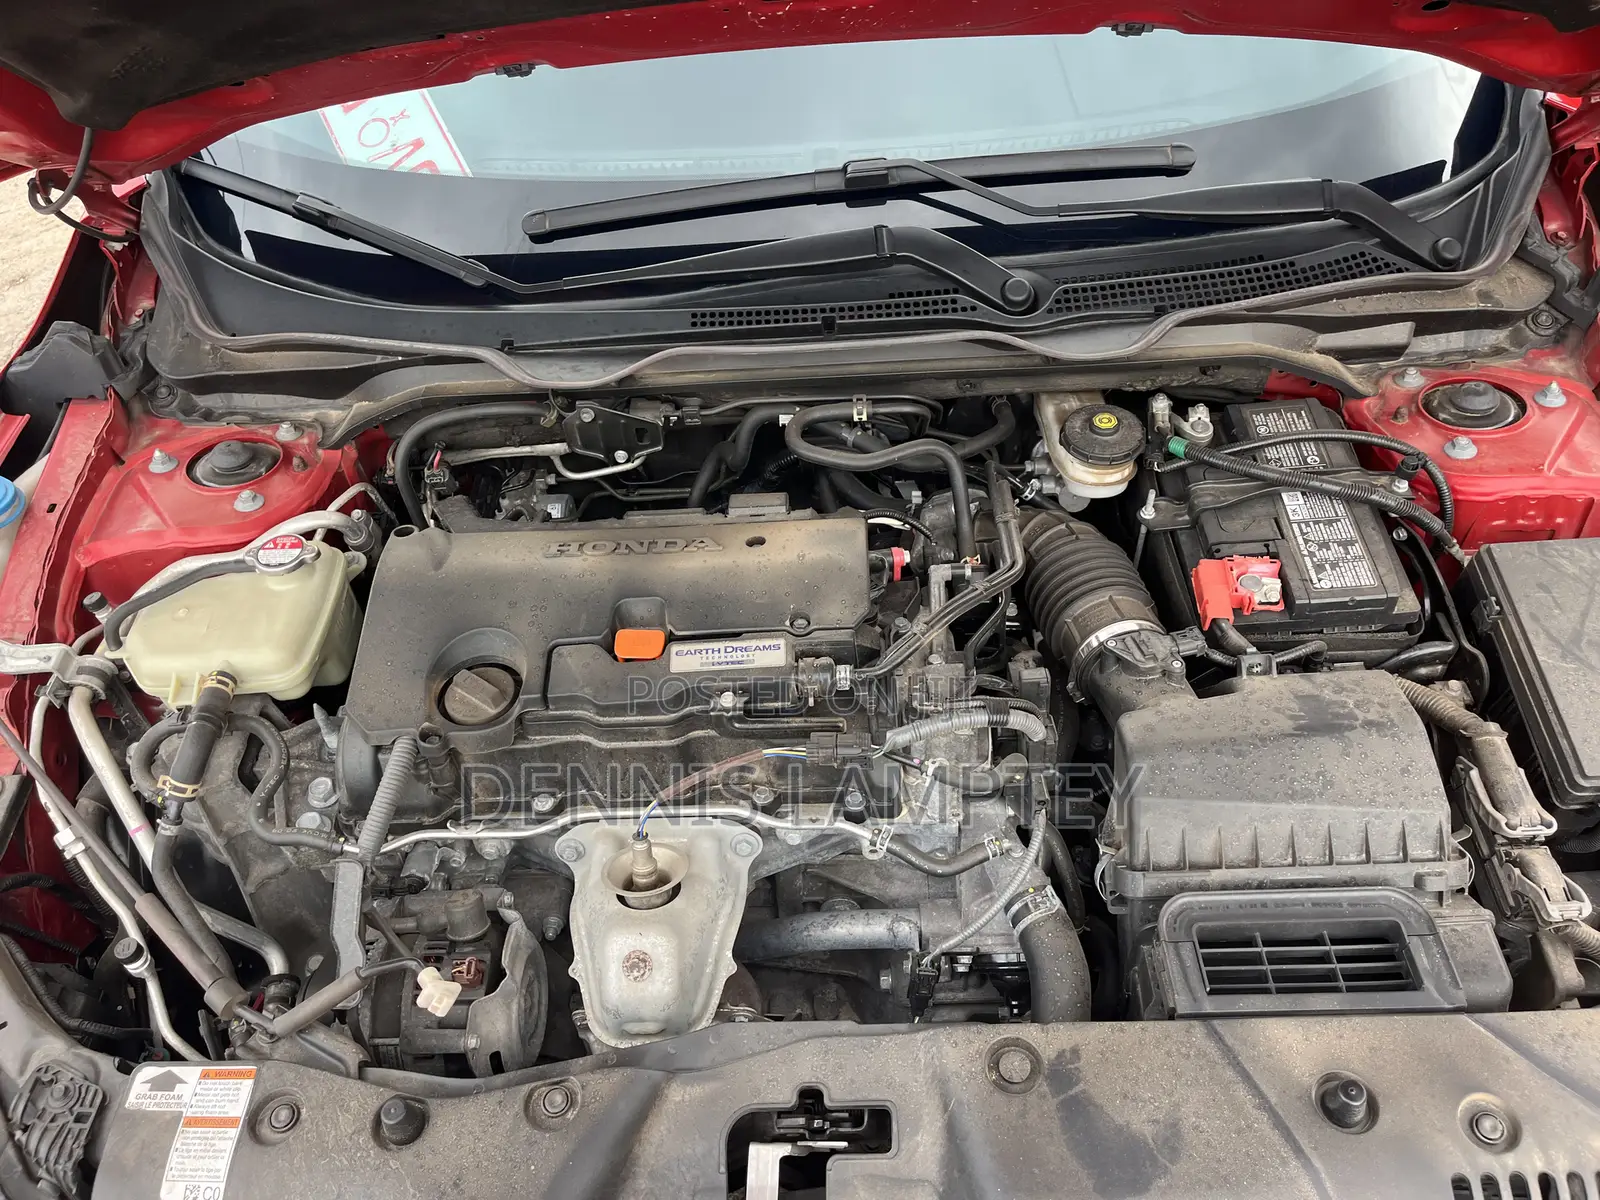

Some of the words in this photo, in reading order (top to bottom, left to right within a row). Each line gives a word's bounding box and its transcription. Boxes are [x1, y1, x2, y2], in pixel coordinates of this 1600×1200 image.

[545, 536, 724, 558] HONDA
[675, 648, 721, 657] EARTH
[724, 643, 781, 653] DREAMS
[700, 653, 756, 661] TECHNOLOGY
[214, 1070, 252, 1078] WARNING
